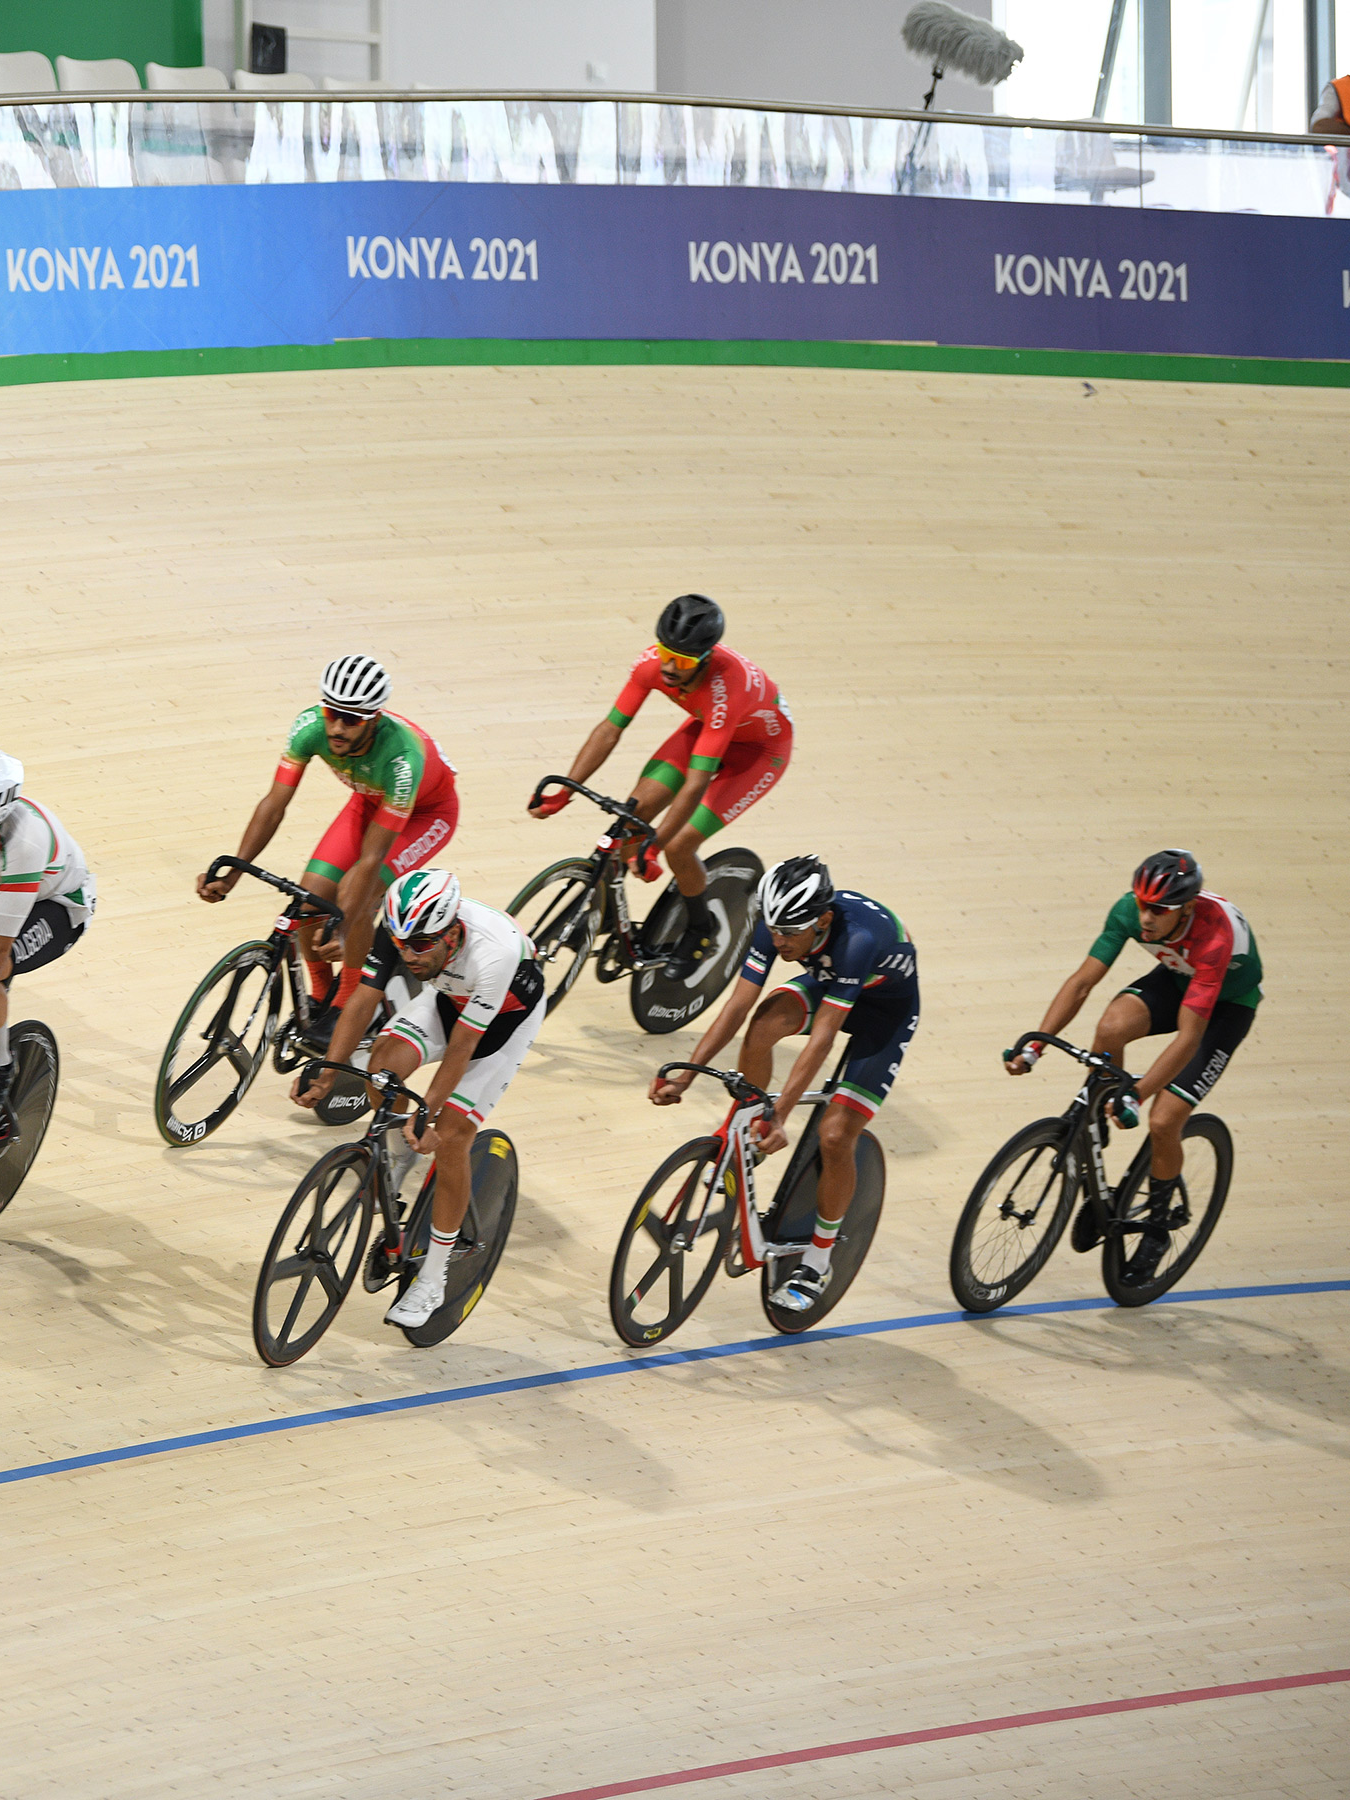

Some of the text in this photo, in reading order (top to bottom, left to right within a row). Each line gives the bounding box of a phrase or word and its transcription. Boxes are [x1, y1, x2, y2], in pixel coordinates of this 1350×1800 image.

[6, 244, 200, 293] KONYA 2021
[346, 234, 539, 281] KONYA 2021
[688, 240, 879, 284] KONYA 2021
[994, 253, 1189, 302] KONYA 2021
[720, 771, 776, 823] MOROCCO
[390, 818, 451, 874] MOROCCO
[1191, 1048, 1230, 1099] ALGERIA
